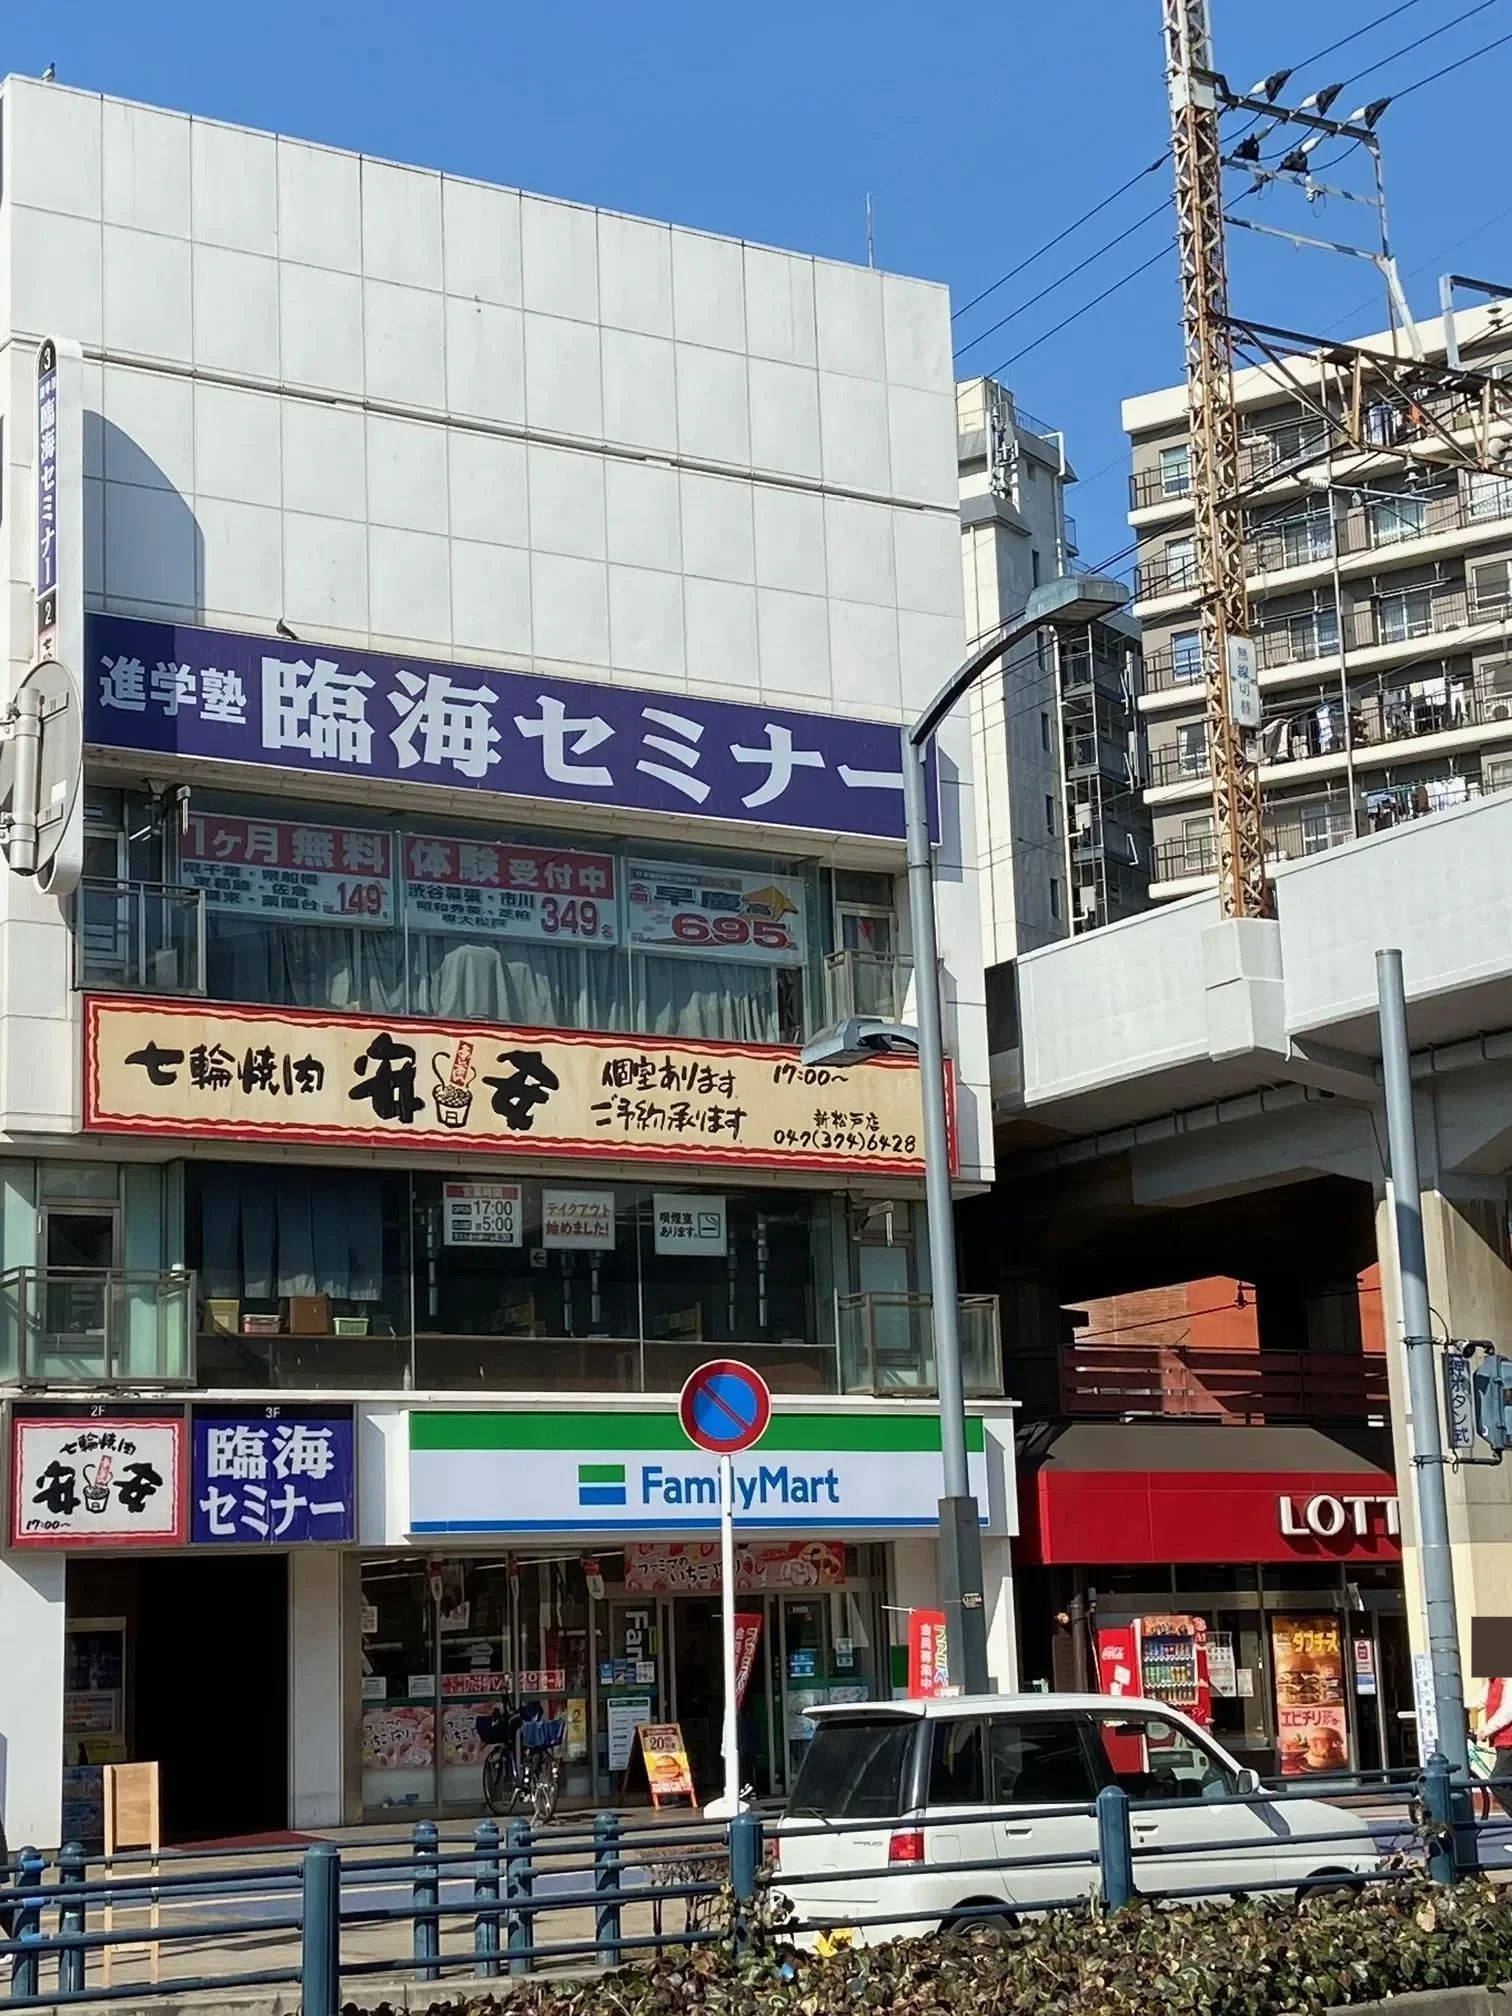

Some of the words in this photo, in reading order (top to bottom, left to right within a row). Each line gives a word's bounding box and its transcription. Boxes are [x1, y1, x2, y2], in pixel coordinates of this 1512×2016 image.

[44, 347, 51, 370] 3
[44, 601, 52, 625] 2
[99, 655, 247, 724] 進学塾
[261, 656, 905, 809] 臨海セミナー
[409, 839, 606, 894] 体験受付中
[124, 1040, 324, 1097] 七輪焼肉
[813, 1108, 881, 1132] 新松戸店
[473, 1200, 513, 1216] 17:00
[545, 1202, 610, 1217] テイクアウト
[659, 1212, 693, 1225] 喫煙室
[90, 1405, 106, 1417] 2F
[265, 1407, 281, 1419] 3F
[207, 1424, 336, 1481] 臨海
[199, 1483, 346, 1537] セミナー
[1279, 1494, 1400, 1536] LOTT
[1280, 1711, 1321, 1727] エビチリ
